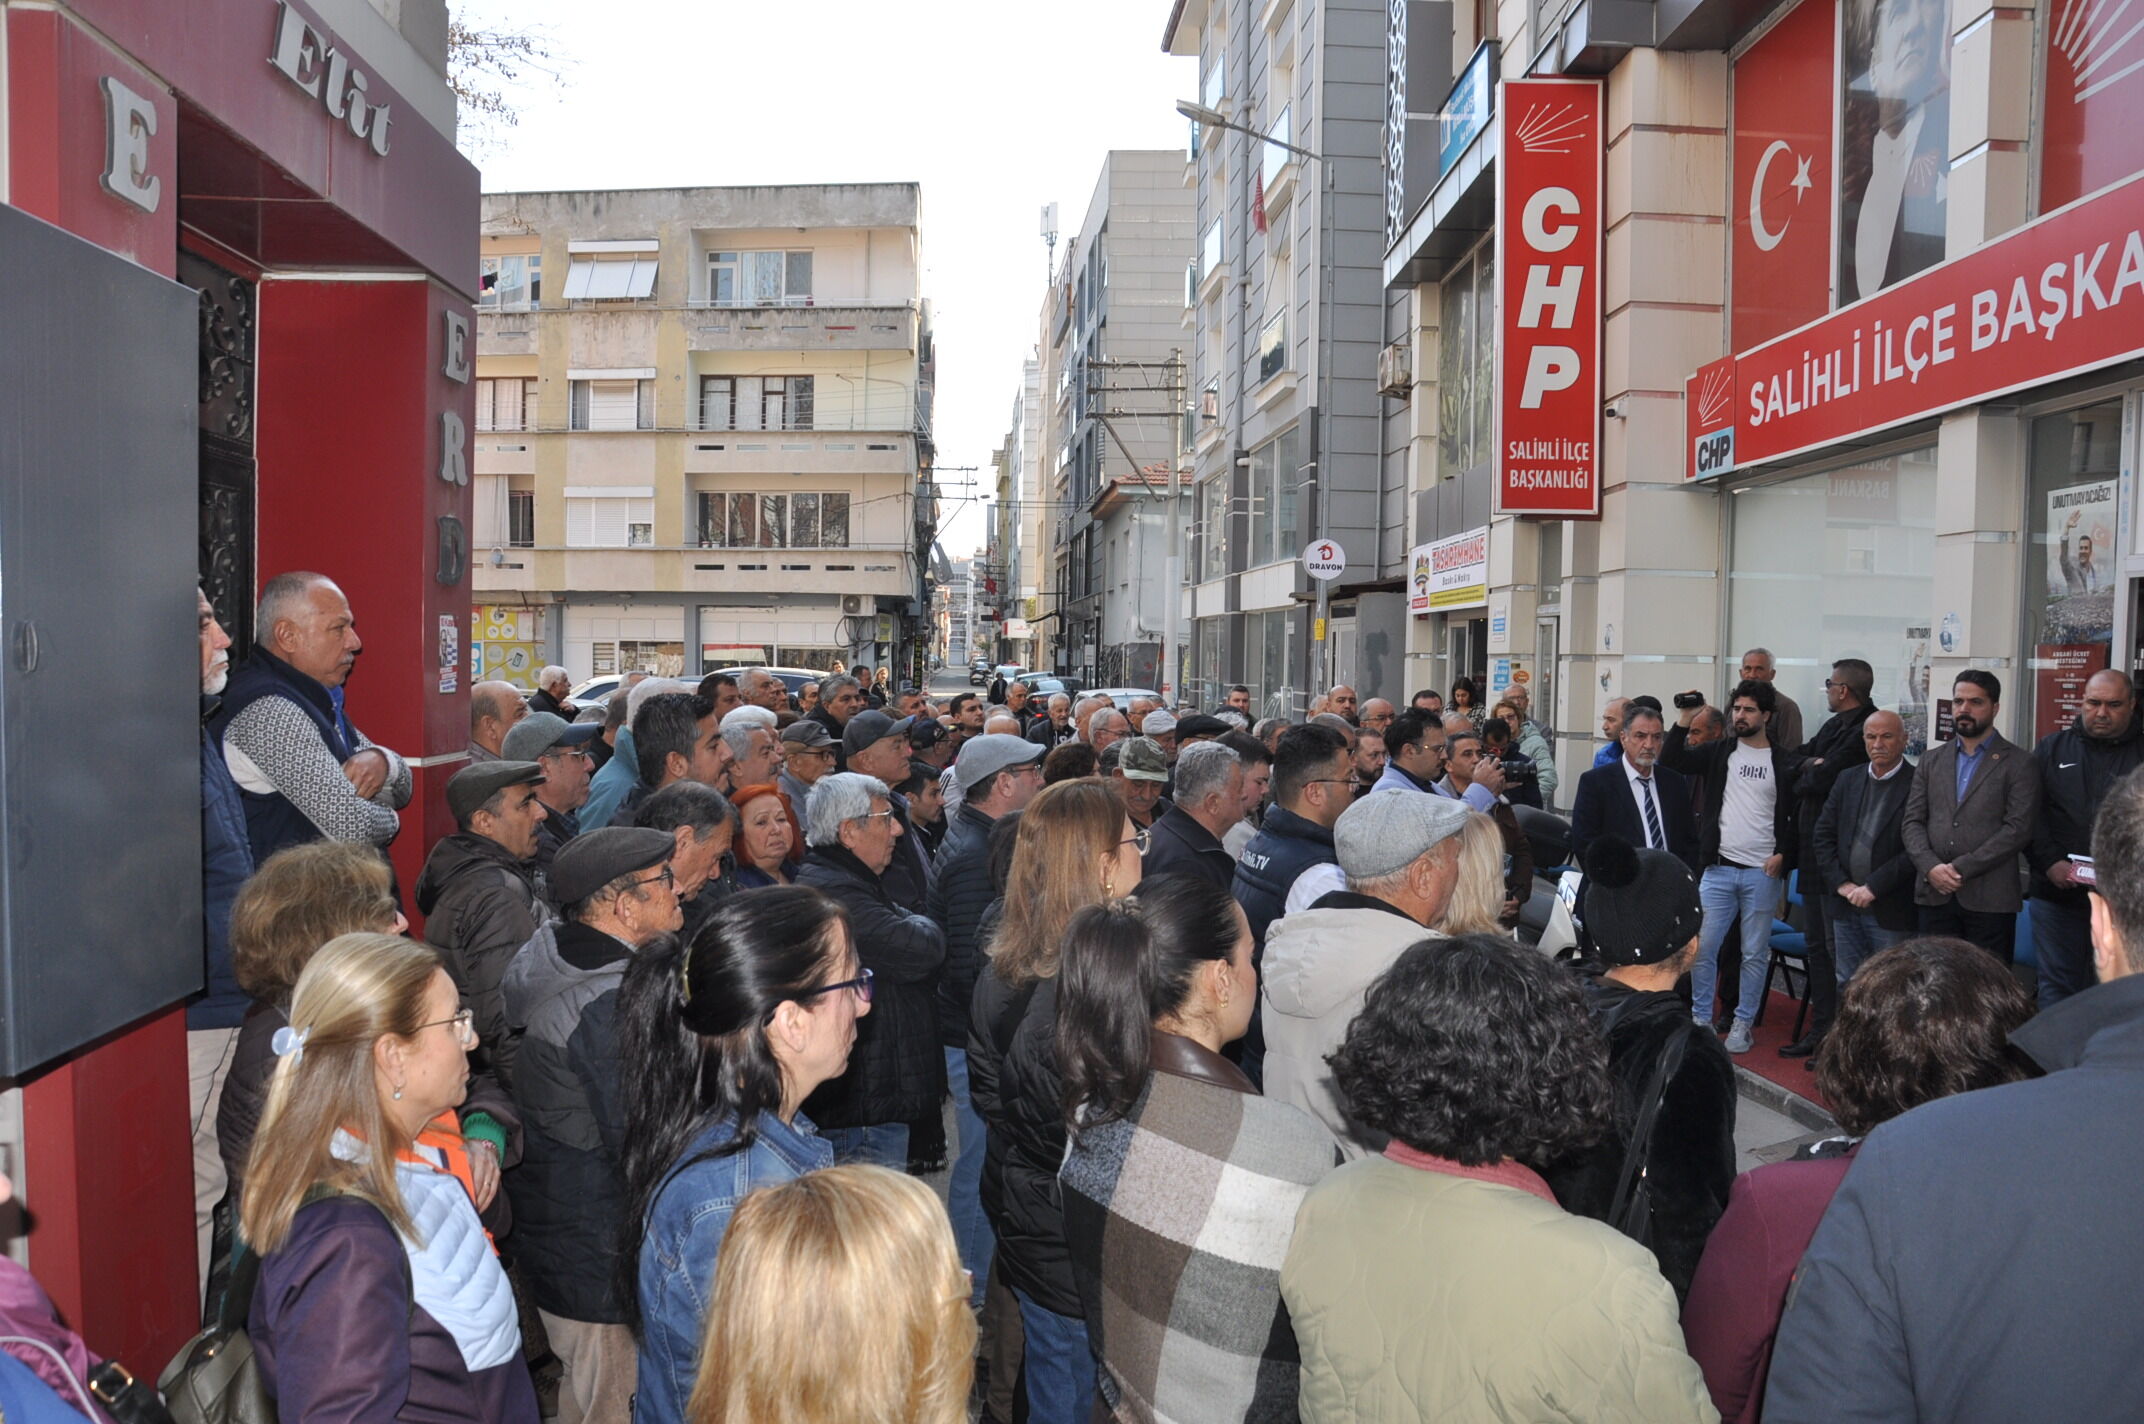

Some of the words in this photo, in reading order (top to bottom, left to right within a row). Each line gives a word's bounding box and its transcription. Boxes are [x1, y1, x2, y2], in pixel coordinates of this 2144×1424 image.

[266, 0, 391, 157] Elit
[1517, 186, 1585, 409] CHP
[1750, 328, 1861, 427] SALİHLİ
[1873, 303, 1956, 386] İLÇE
[1971, 229, 2144, 352] BAŞKA
[1509, 437, 1560, 460] SALİHLİ
[1563, 437, 1589, 463] İLÇE
[1698, 434, 1731, 472] CHP
[1509, 466, 1588, 491] BAŞKANLIĞI
[1309, 563, 1343, 571] DRAVON
